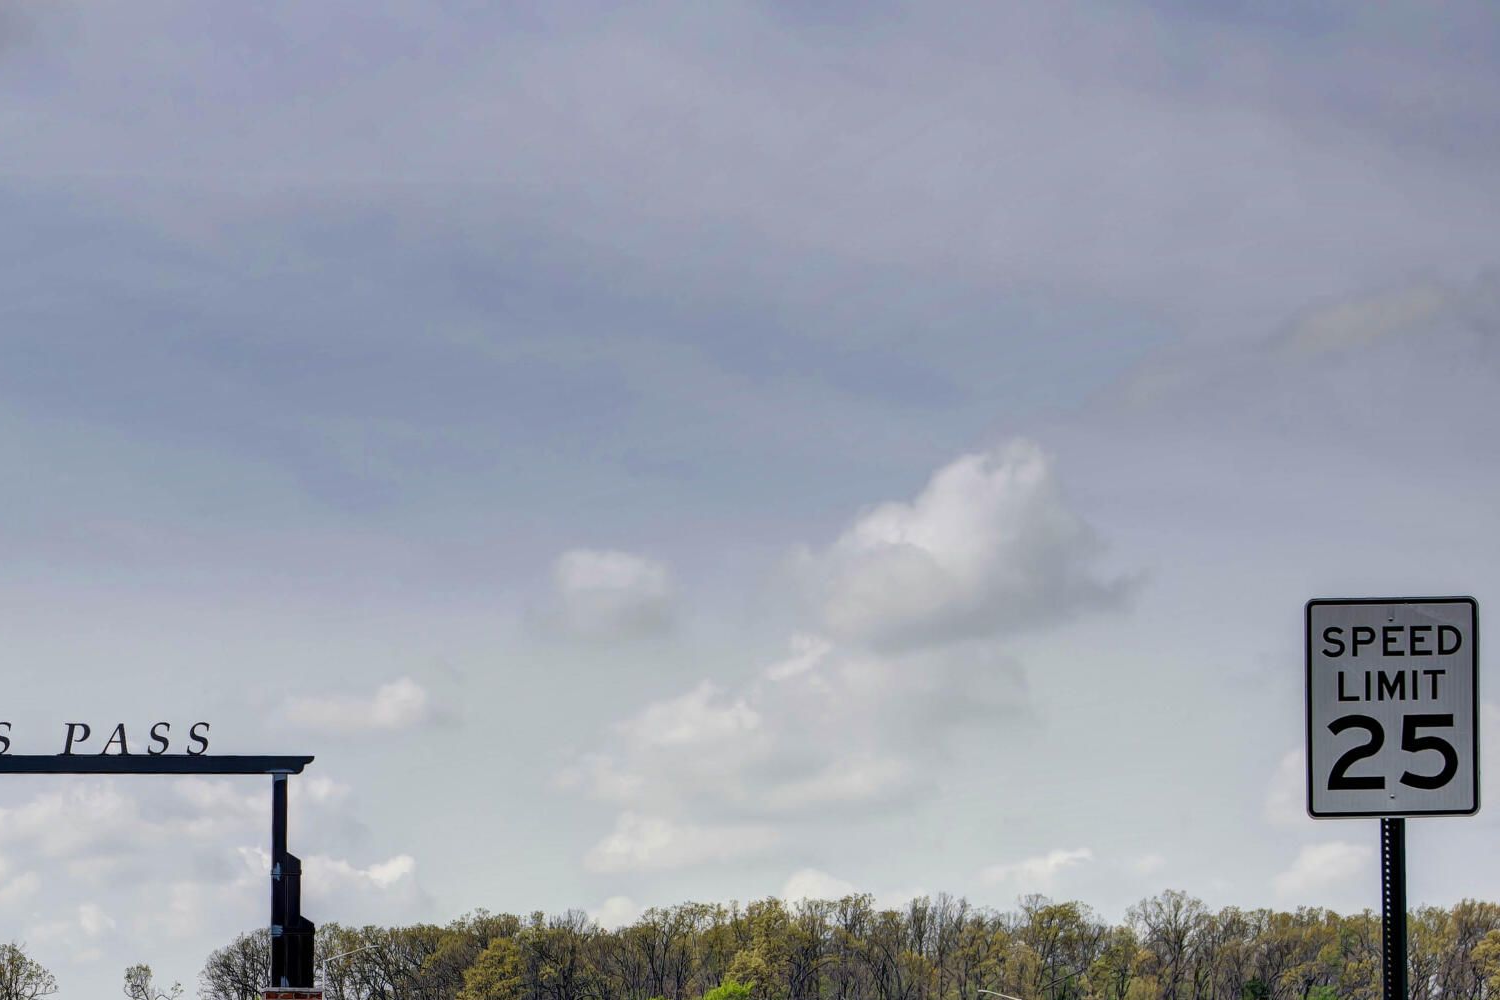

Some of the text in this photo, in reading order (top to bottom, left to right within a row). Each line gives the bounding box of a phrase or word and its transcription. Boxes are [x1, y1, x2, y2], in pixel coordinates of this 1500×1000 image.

[1322, 625, 1462, 658] SPEED
[1337, 669, 1446, 701] LIMIT
[58, 722, 210, 755] PASS
[1327, 713, 1459, 790] 25
